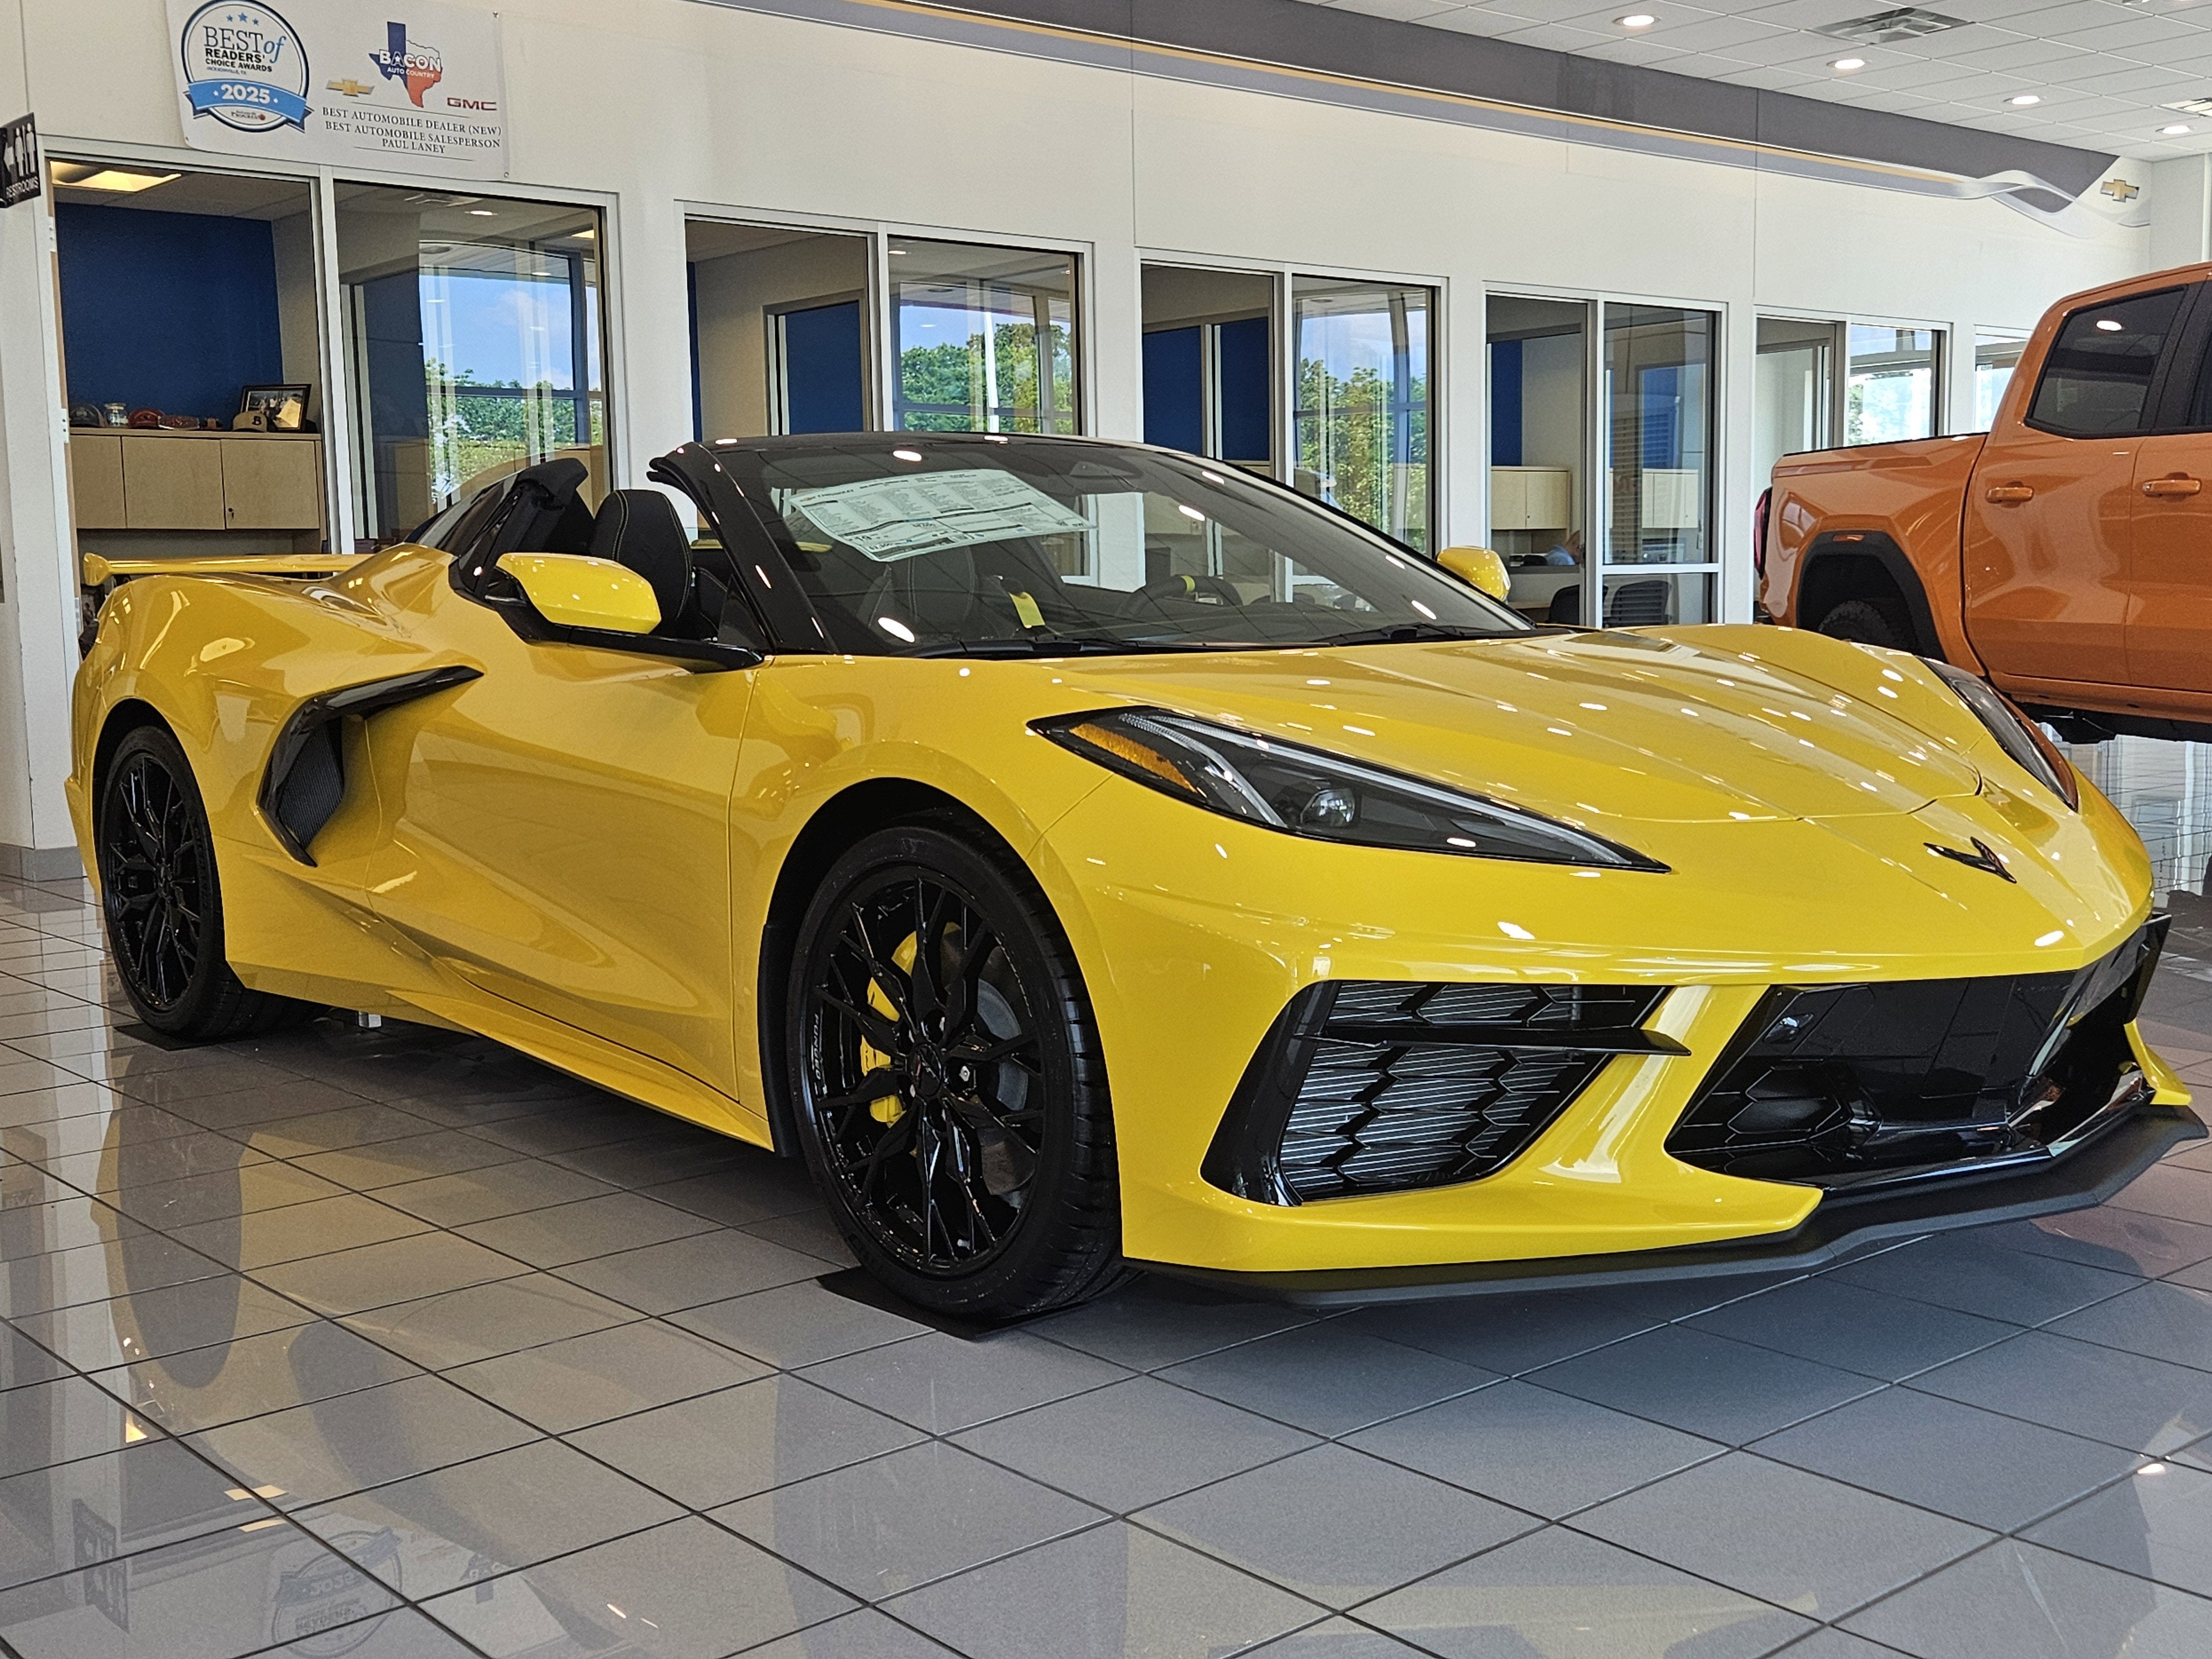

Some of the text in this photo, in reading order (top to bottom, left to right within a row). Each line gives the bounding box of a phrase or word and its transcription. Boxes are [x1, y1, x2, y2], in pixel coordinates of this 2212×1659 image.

[202, 25, 286, 64] BEST of
[205, 48, 265, 63] READERS'
[379, 49, 441, 72] BACON
[206, 58, 272, 72] CHOICE AWARDS
[387, 66, 435, 79] AUTO COUNTRY
[221, 84, 270, 104] 2025
[447, 97, 497, 111] GMC
[322, 107, 502, 136] BEST AUTOMOBILE DEALER (NEW)
[325, 121, 500, 148] BEST AUTOMOBILE SALESPERSON
[382, 138, 446, 154] PAUL LANEY
